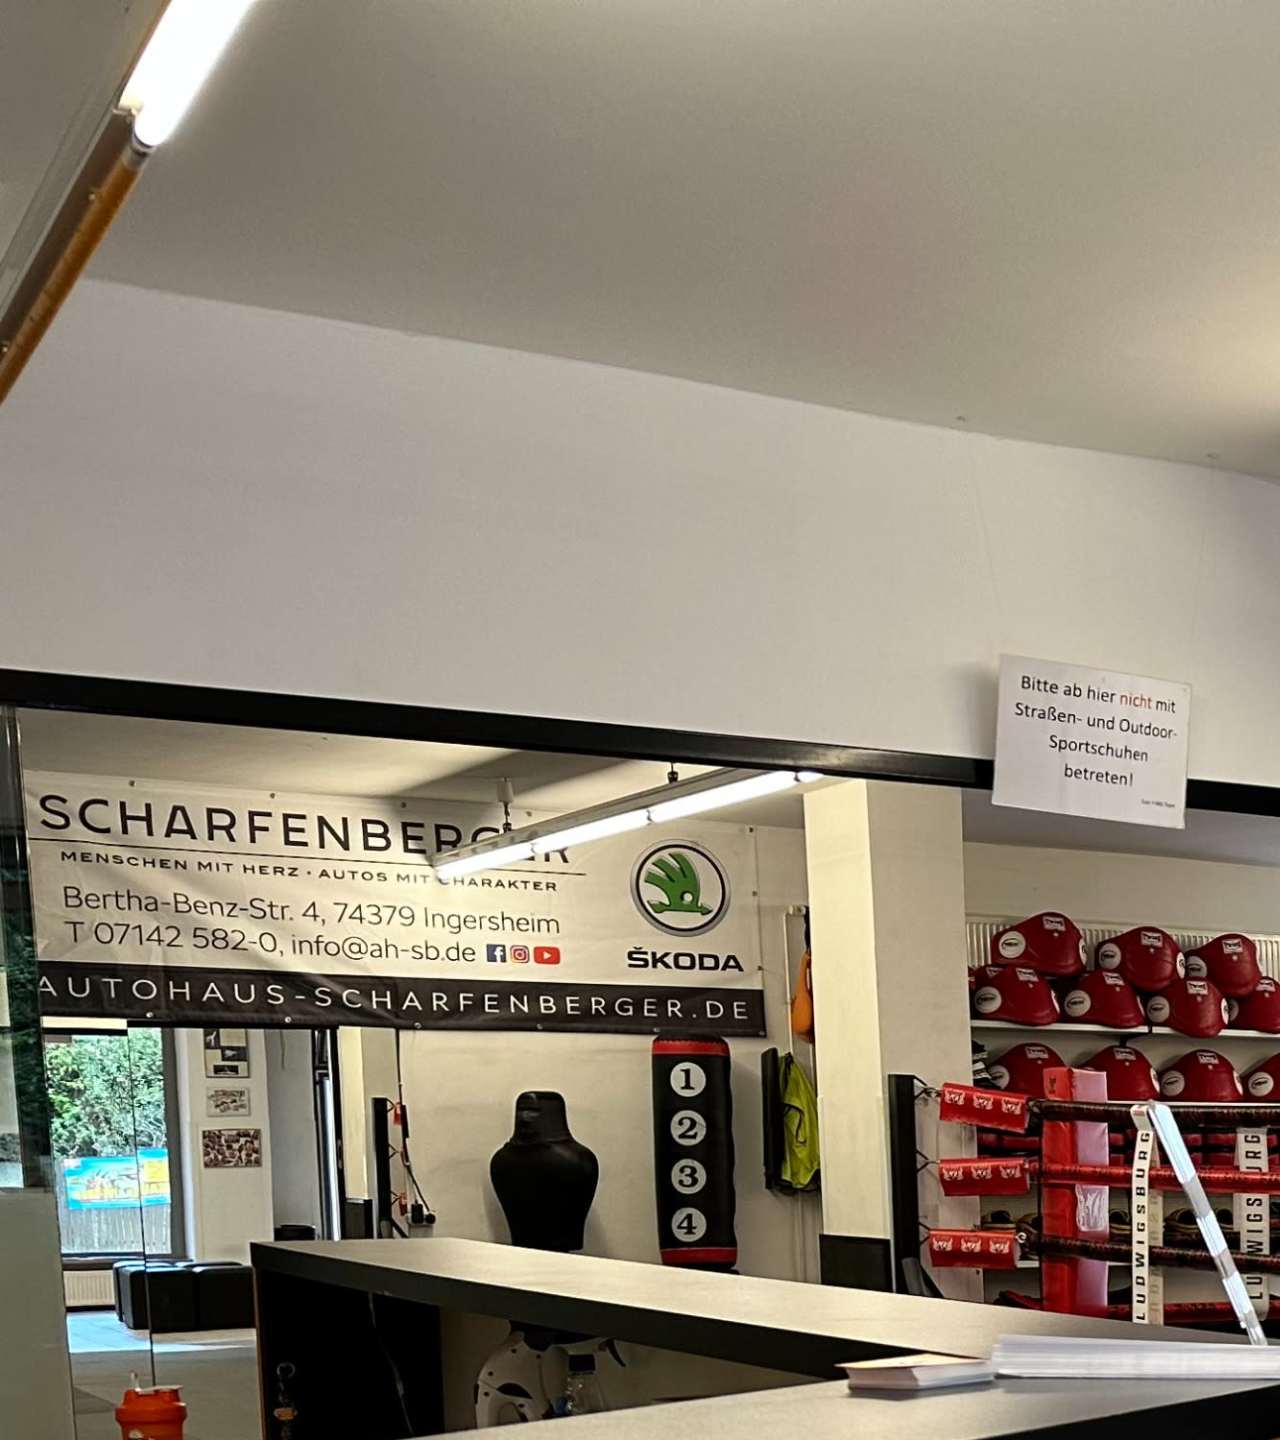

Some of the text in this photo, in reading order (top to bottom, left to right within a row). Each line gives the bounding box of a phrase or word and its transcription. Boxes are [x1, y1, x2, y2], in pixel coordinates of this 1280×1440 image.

[1021, 675, 1177, 714] Bitte ab hier nicht mit
[1015, 702, 1179, 741] Straßen- und Outdoor-
[1049, 735, 1149, 763] Sportschuhen
[1064, 763, 1134, 788] betreten!
[60, 850, 188, 871] MENSCHEN
[197, 860, 235, 874] MIT
[242, 863, 300, 878] HERZ
[318, 868, 389, 883] AUTOS
[396, 872, 434, 885] MIT
[63, 885, 561, 936] Bertha-Benz-Str. 4, 74379 Ingersheim
[64, 921, 477, 963] T 07142 582-0, info@ah-sb.de
[626, 946, 745, 973] ŠKODA
[38, 975, 749, 1020] AUTOHAUS-SCHARFENBERGER.DE
[679, 1068, 696, 1090] 1
[677, 1116, 699, 1140] 2
[677, 1165, 700, 1188] 3
[676, 1213, 698, 1236] 4
[1135, 1131, 1152, 1322] LUDWIGSBURG
